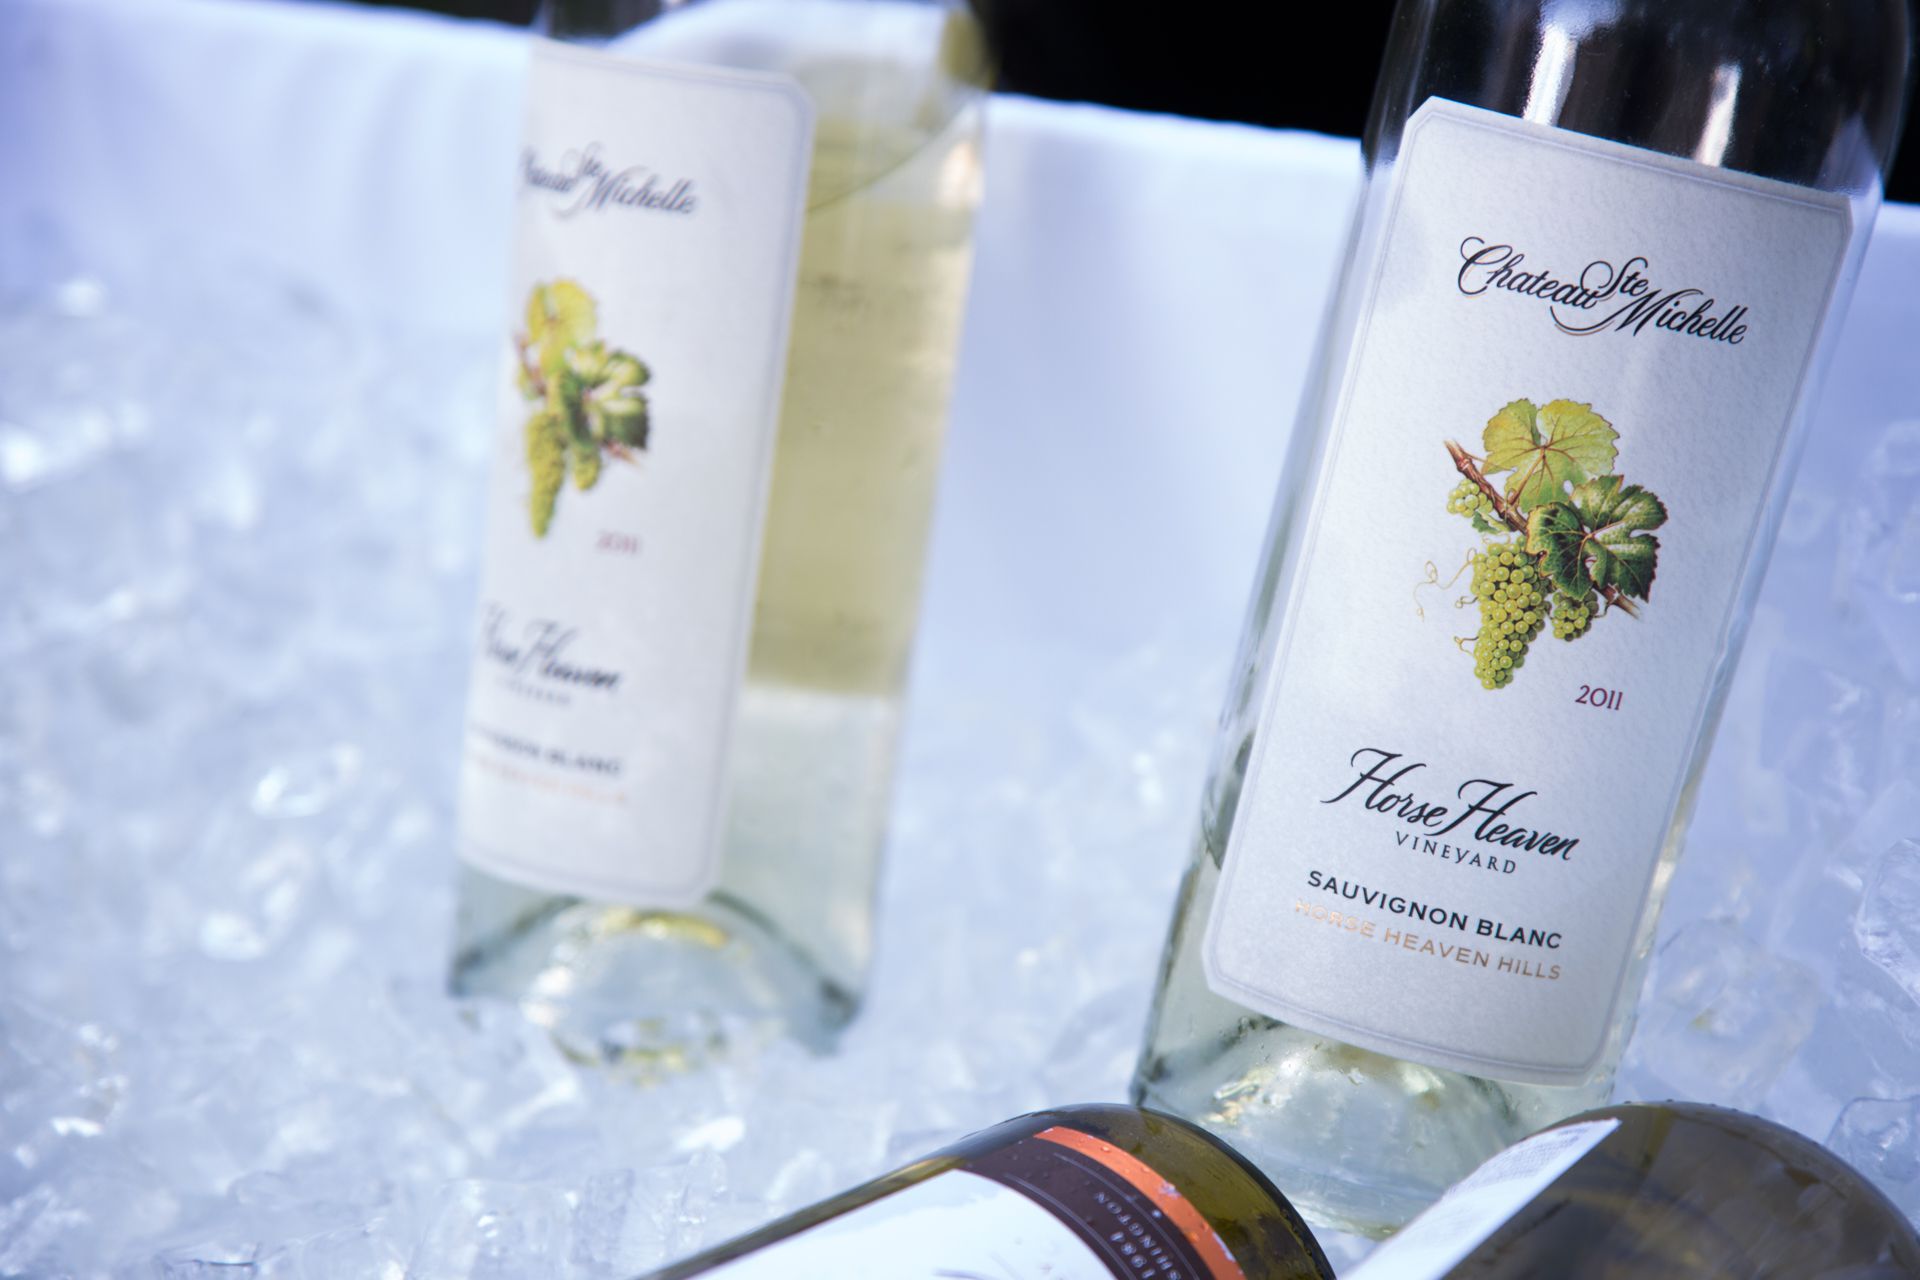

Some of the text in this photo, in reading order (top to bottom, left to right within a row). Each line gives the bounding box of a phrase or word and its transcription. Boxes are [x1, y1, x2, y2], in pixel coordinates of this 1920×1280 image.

[1458, 236, 1749, 345] Chateau Ste Michelle
[1575, 684, 1624, 711] 2011
[1319, 747, 1581, 861] Horse Heaven
[1396, 830, 1517, 875] VINEYARD
[1294, 898, 1562, 980] HORSE HEAVEN HILLS
[1307, 870, 1563, 949] SAUVIGNON BLANC
